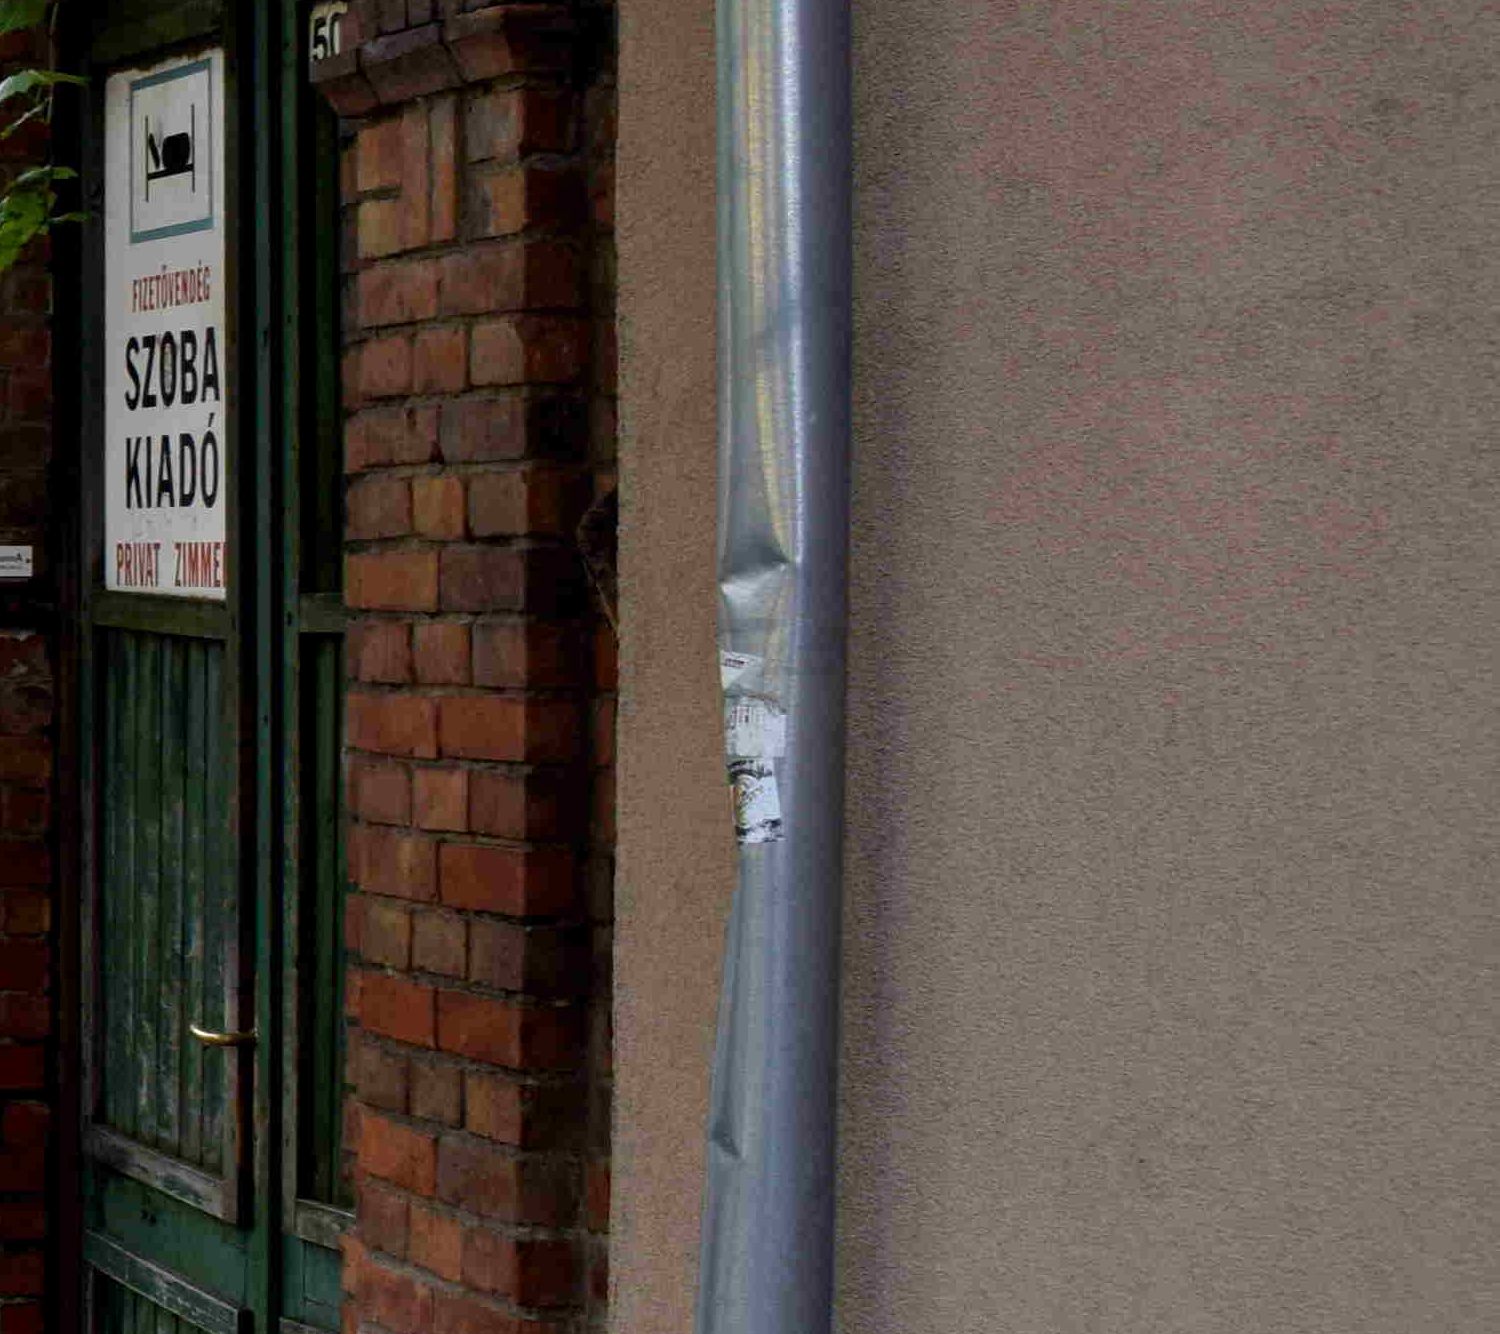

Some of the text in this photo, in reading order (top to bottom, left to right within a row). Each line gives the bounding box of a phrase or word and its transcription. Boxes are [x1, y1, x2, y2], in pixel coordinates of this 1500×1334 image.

[124, 326, 220, 411] SZOBA
[125, 413, 219, 510] KIADÓ
[116, 540, 161, 587] PRIVAT
